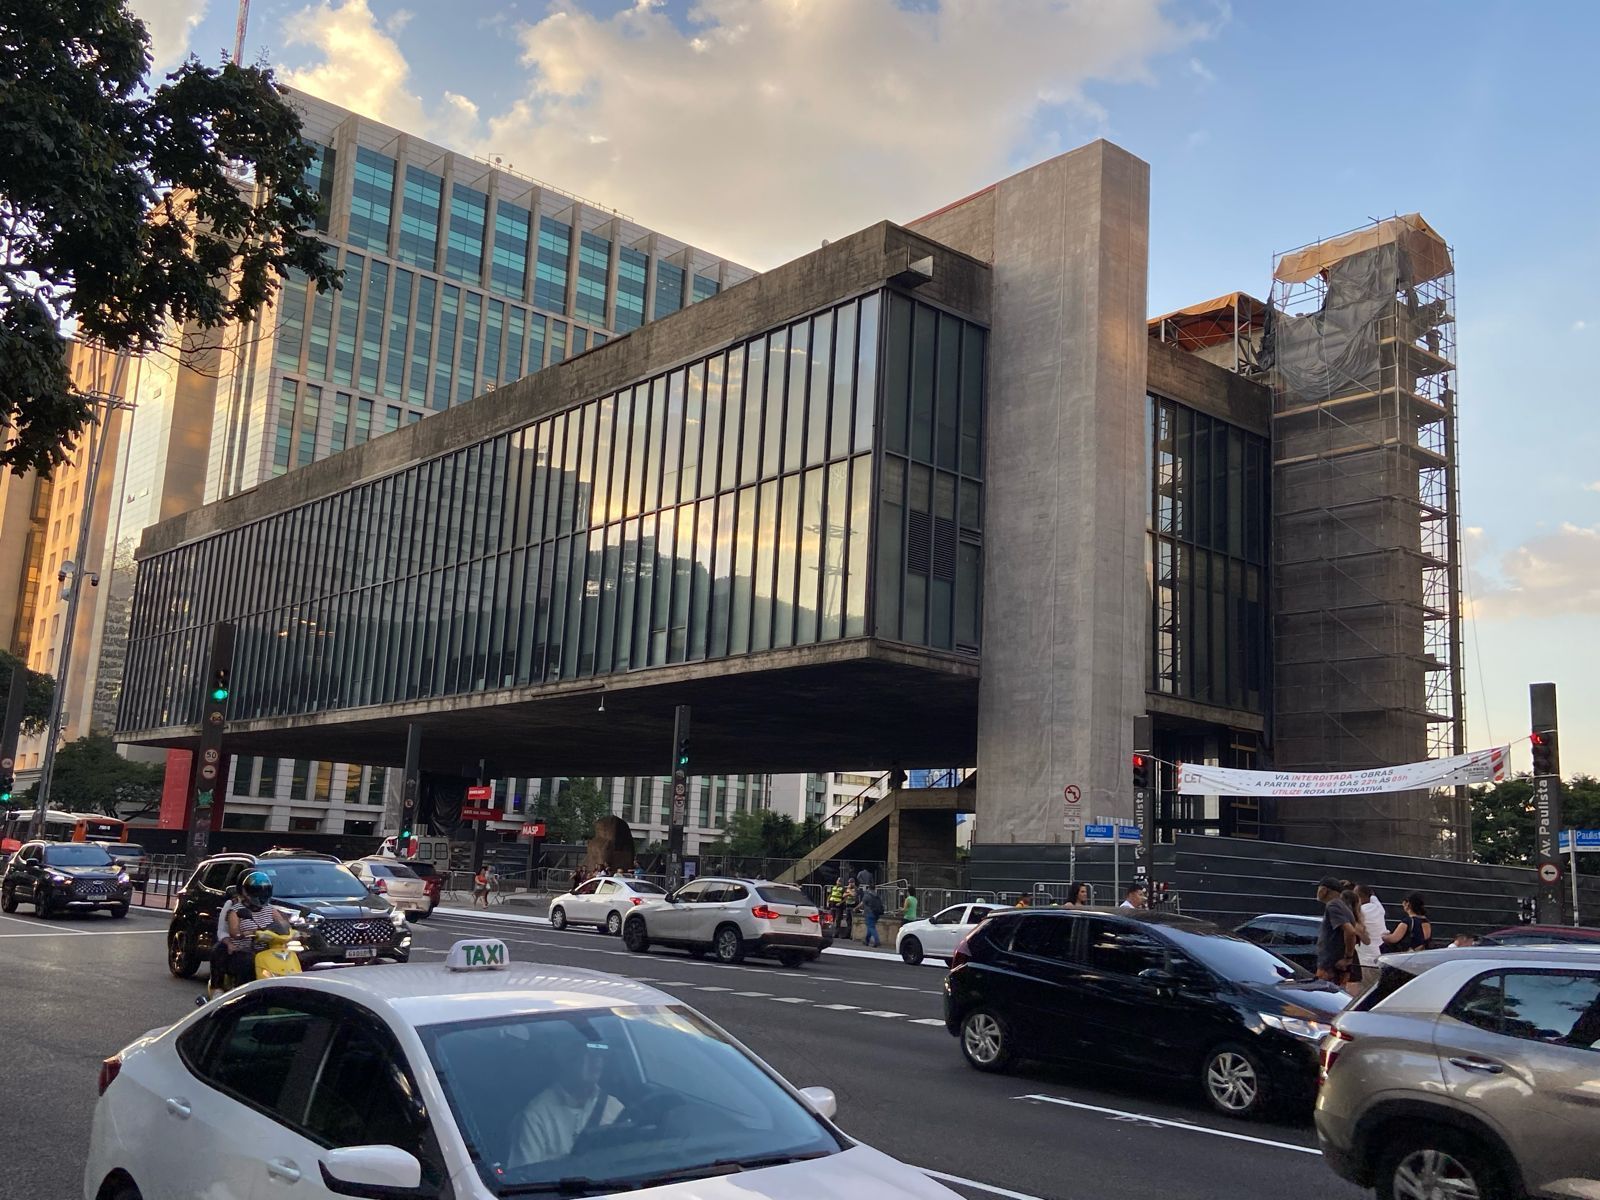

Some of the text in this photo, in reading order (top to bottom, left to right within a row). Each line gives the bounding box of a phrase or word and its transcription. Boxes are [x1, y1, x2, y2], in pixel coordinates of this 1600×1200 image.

[1184, 773, 1202, 784] CET
[1291, 773, 1353, 781] INTERDITADA
[1360, 769, 1394, 779] OBRAS
[1326, 785, 1383, 795] ALTERNATIVA
[1136, 792, 1145, 838] aulista
[1538, 779, 1551, 858] Av. Paulista
[522, 825, 539, 836] MASP
[461, 943, 504, 966] TAXI
